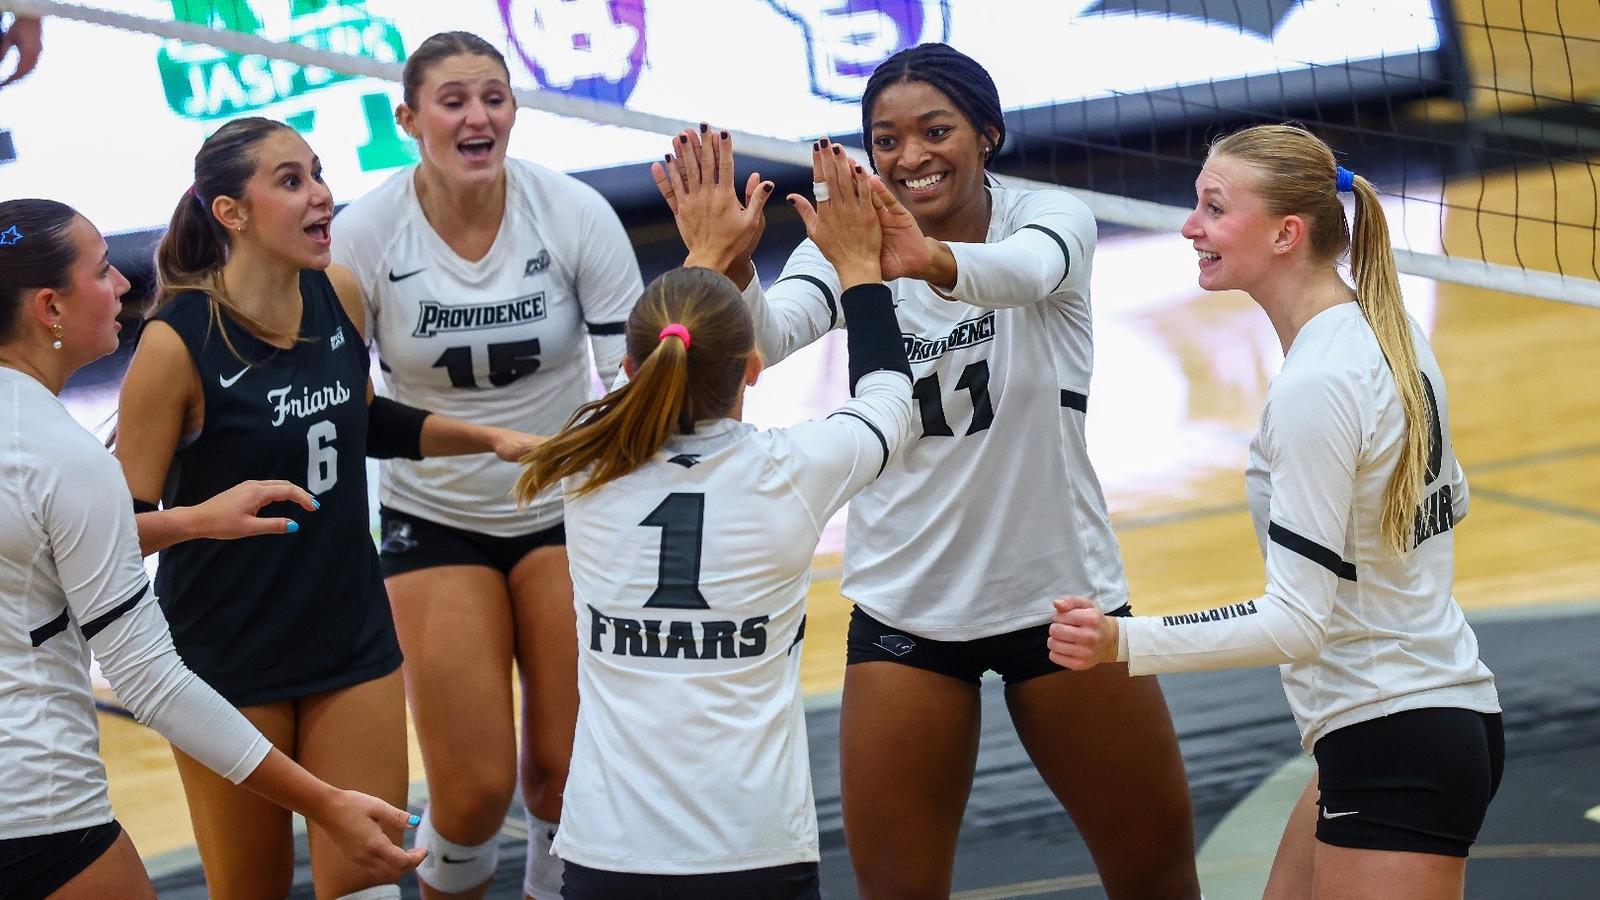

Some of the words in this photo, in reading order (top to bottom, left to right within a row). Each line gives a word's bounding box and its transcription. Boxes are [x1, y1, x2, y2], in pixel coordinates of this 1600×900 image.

[417, 296, 545, 334] PROVIDENCE
[431, 338, 541, 388] 15
[267, 380, 350, 427] Friars
[912, 359, 995, 440] 11
[307, 420, 338, 495] 6
[638, 492, 711, 609] 1
[587, 603, 770, 660] FRIARS
